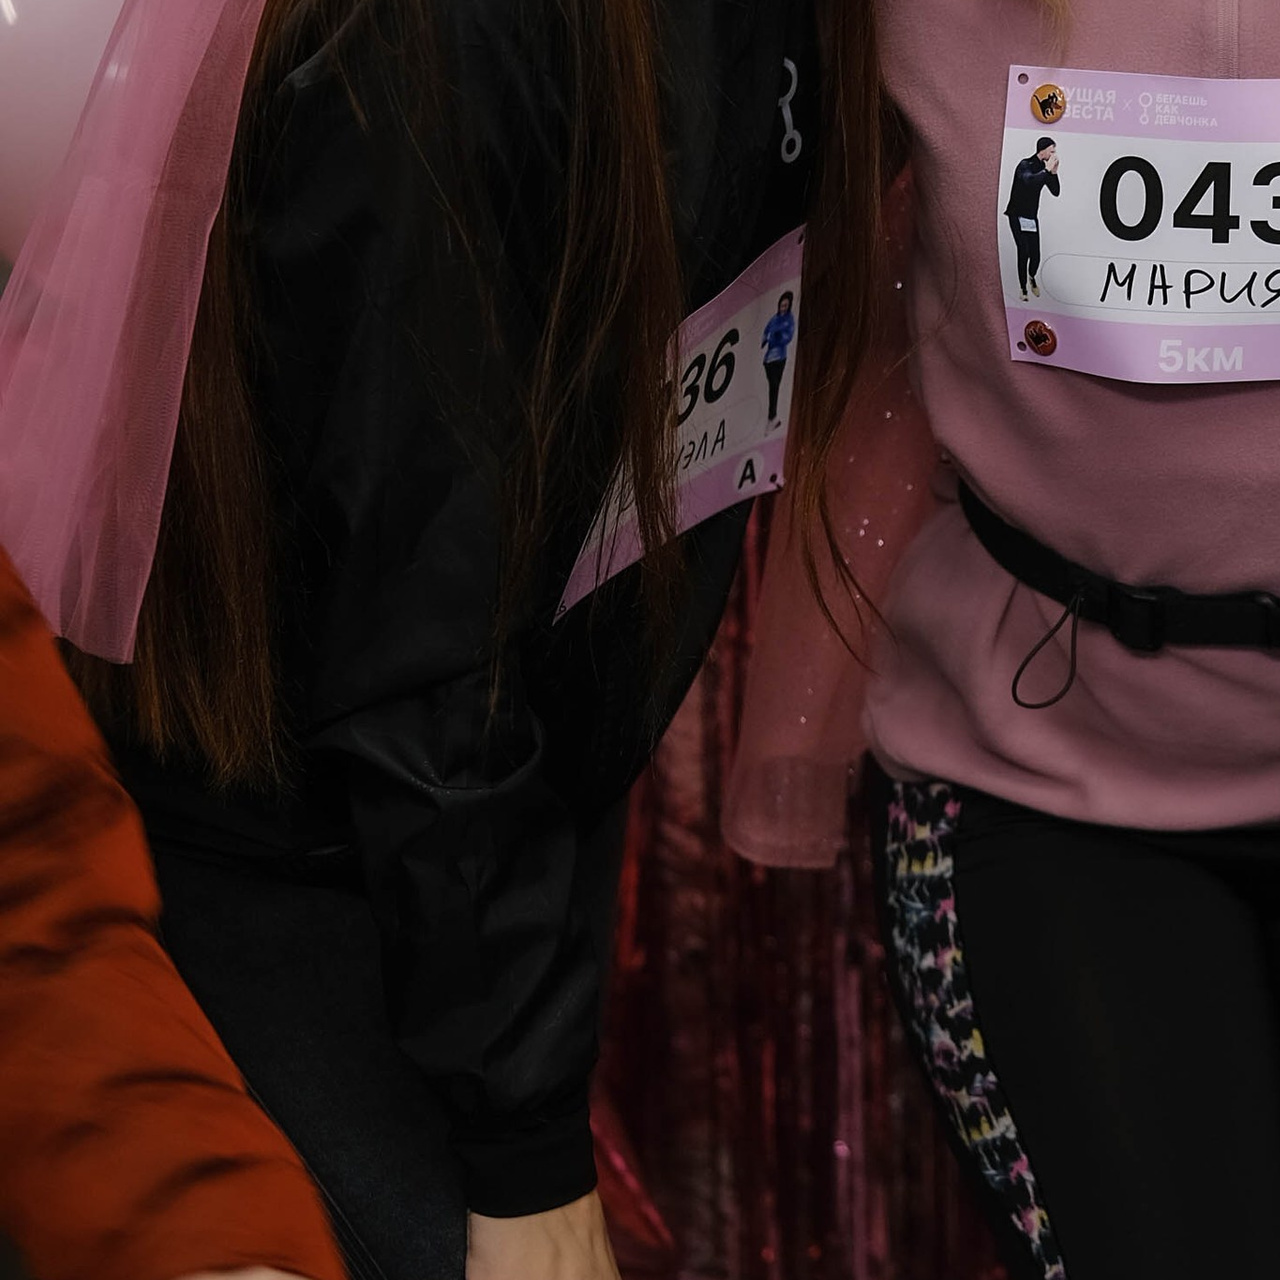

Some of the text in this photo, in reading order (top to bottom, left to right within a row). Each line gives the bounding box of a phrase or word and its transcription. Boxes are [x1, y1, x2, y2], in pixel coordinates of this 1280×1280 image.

[1060, 85, 1117, 105] УЩАЯ
[1064, 103, 1114, 122] ВЕСТА
[1154, 114, 1218, 128] ДЕВЧОНКА
[676, 328, 740, 426] 36
